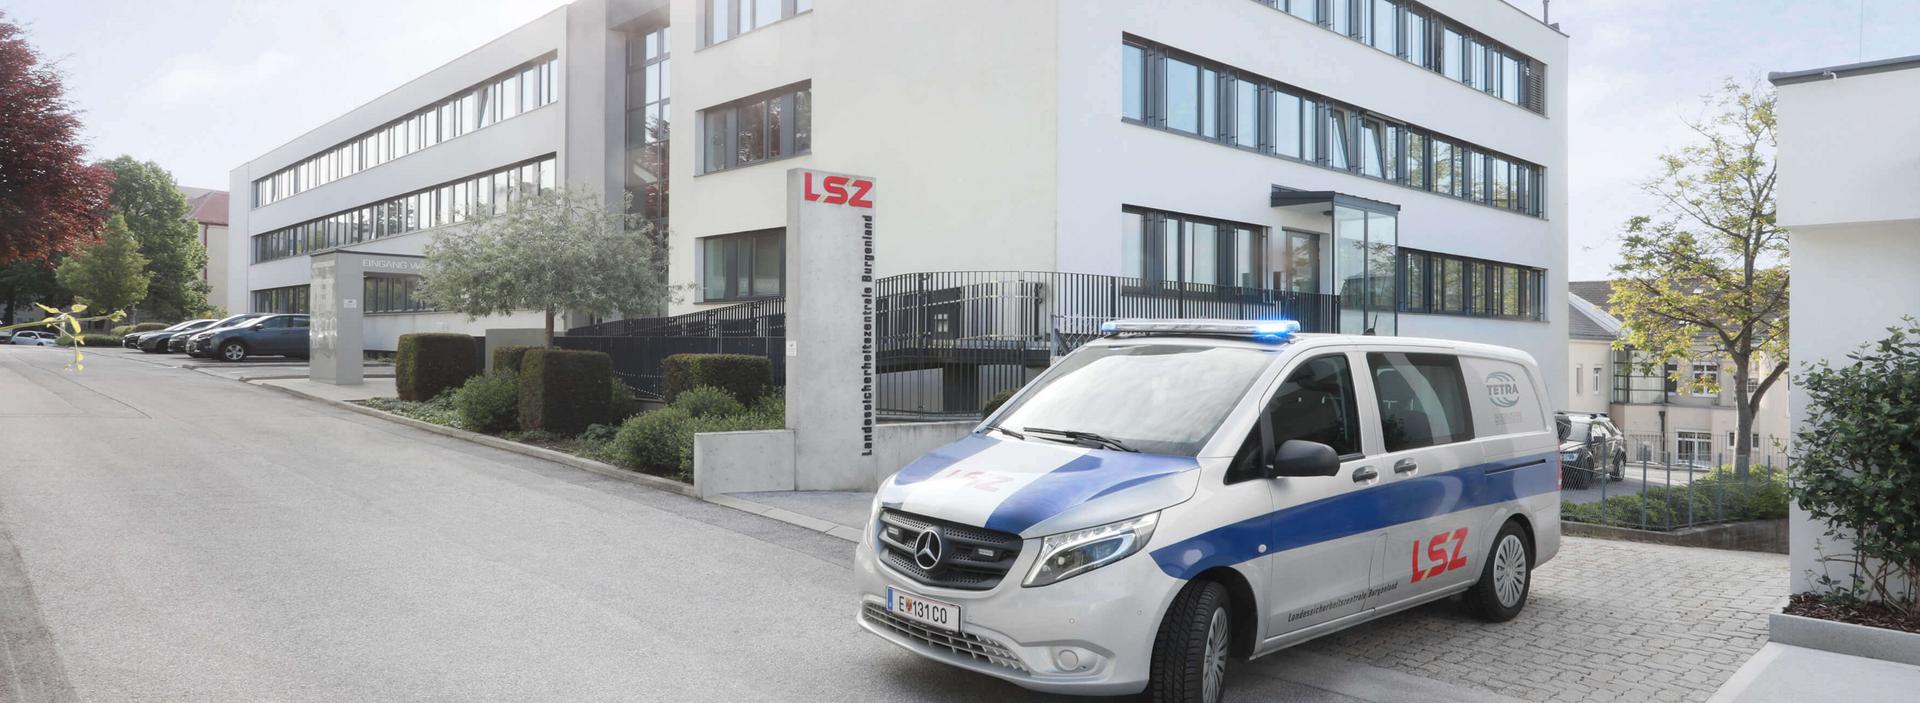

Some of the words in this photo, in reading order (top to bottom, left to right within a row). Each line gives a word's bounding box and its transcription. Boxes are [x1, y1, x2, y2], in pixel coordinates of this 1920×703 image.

[804, 172, 873, 208] LSZ
[362, 259, 407, 269] EINGANG
[861, 215, 875, 282] Burgenland
[861, 287, 873, 456] Landessicherheitszentrale
[1486, 383, 1519, 395] TETRA
[1411, 527, 1469, 583] LSZ
